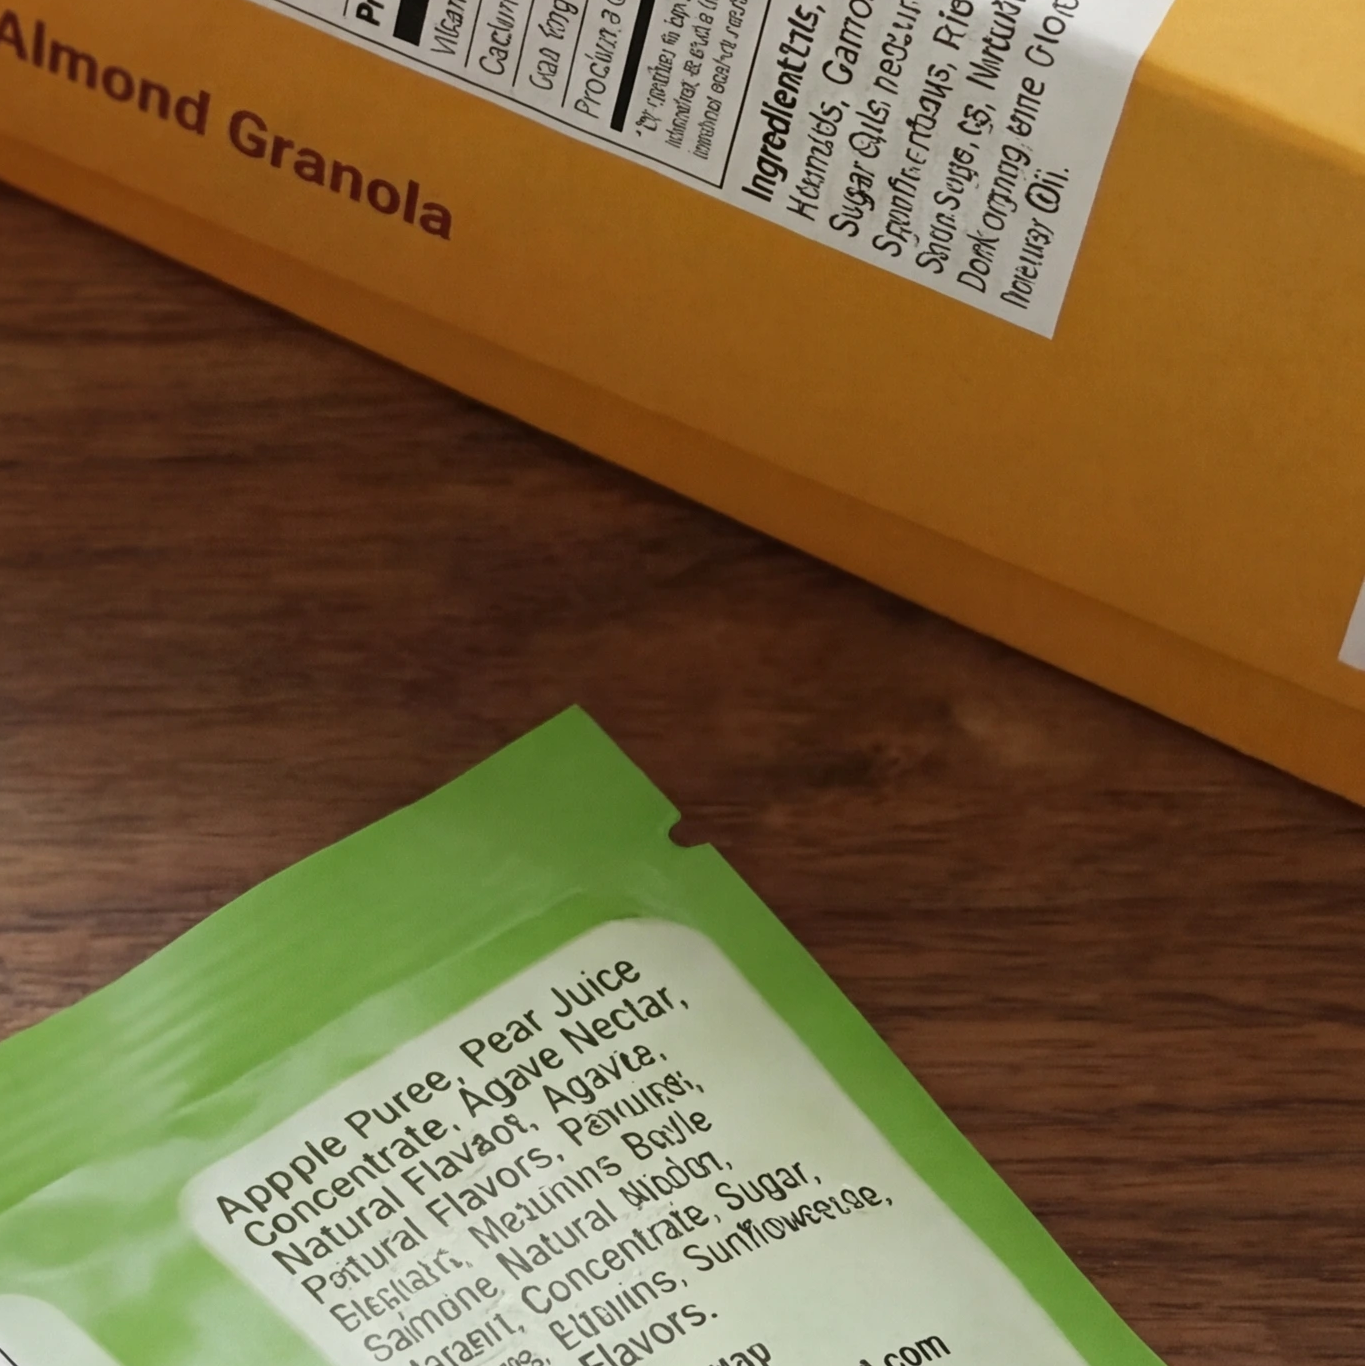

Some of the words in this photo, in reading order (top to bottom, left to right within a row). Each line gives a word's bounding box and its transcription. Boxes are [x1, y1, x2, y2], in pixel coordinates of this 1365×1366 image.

[228, 110, 453, 241] Granola
[343, 1070, 466, 1141] Puree,
[458, 1008, 544, 1069] Pear
[550, 960, 641, 1019] Juice
[243, 1118, 462, 1248] Concentrate,
[457, 1047, 565, 1119] Agave
[558, 986, 689, 1056] Nectar,
[270, 1184, 406, 1276] Natural
[424, 1147, 565, 1228] Flavors,
[494, 1197, 619, 1281] Natural
[520, 1204, 722, 1315] Concentrate,
[714, 1161, 822, 1212] Sugar,
